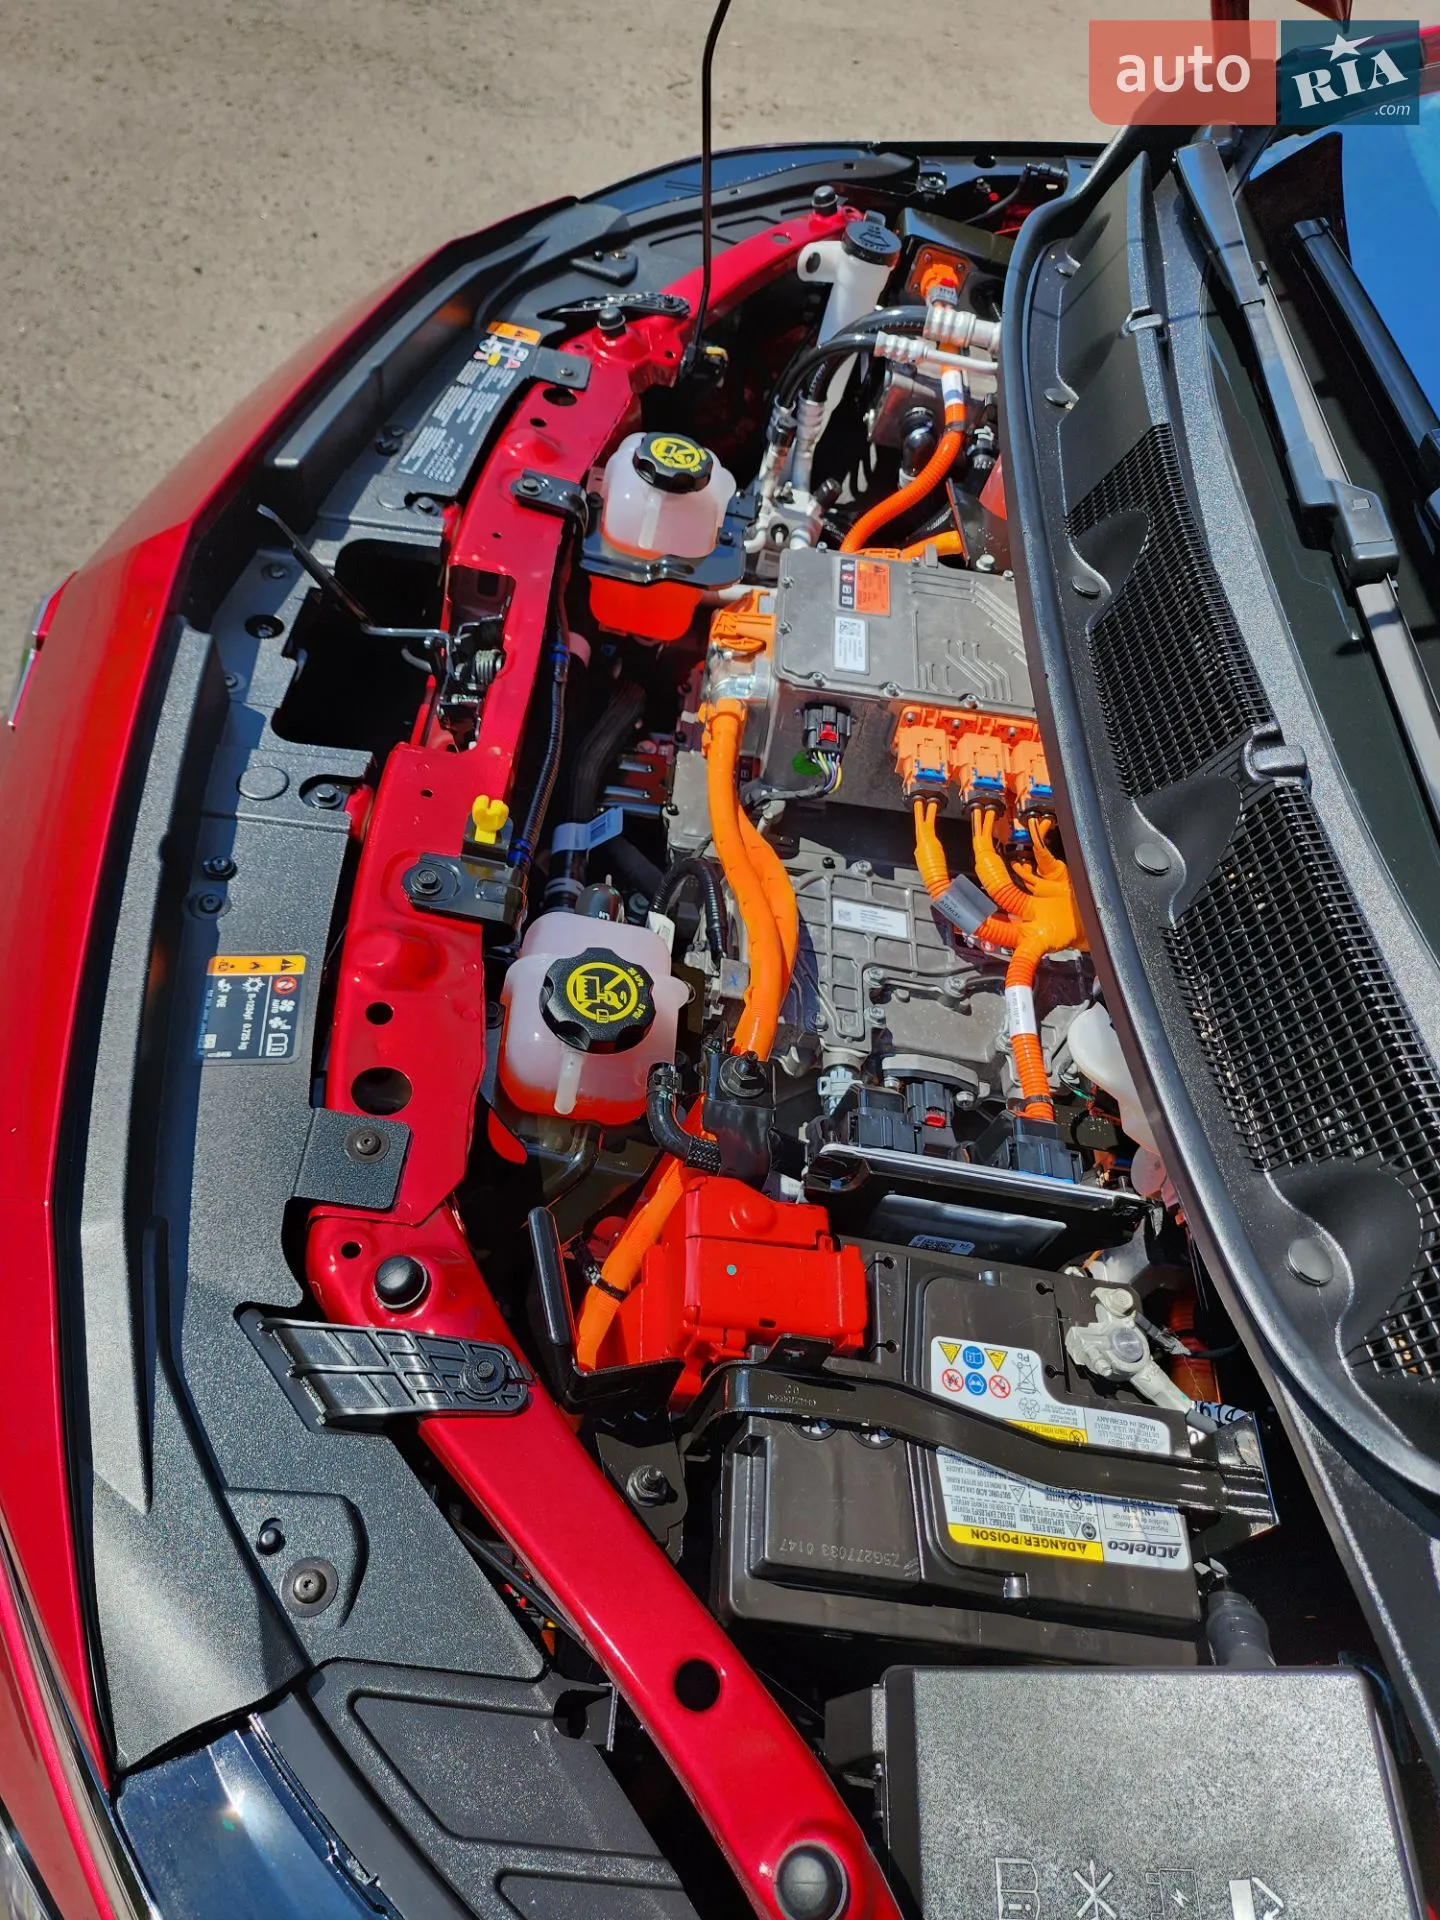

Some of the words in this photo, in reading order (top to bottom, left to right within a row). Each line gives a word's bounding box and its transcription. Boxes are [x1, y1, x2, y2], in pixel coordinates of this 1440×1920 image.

[240, 1023, 252, 1040] 0.725
[1017, 1352, 1029, 1362] Pb
[1097, 1415, 1127, 1425] GERMANY
[1138, 1422, 1155, 1431] MADE
[976, 1487, 986, 1495] ACID
[970, 1528, 1075, 1551] DANGER/POISON
